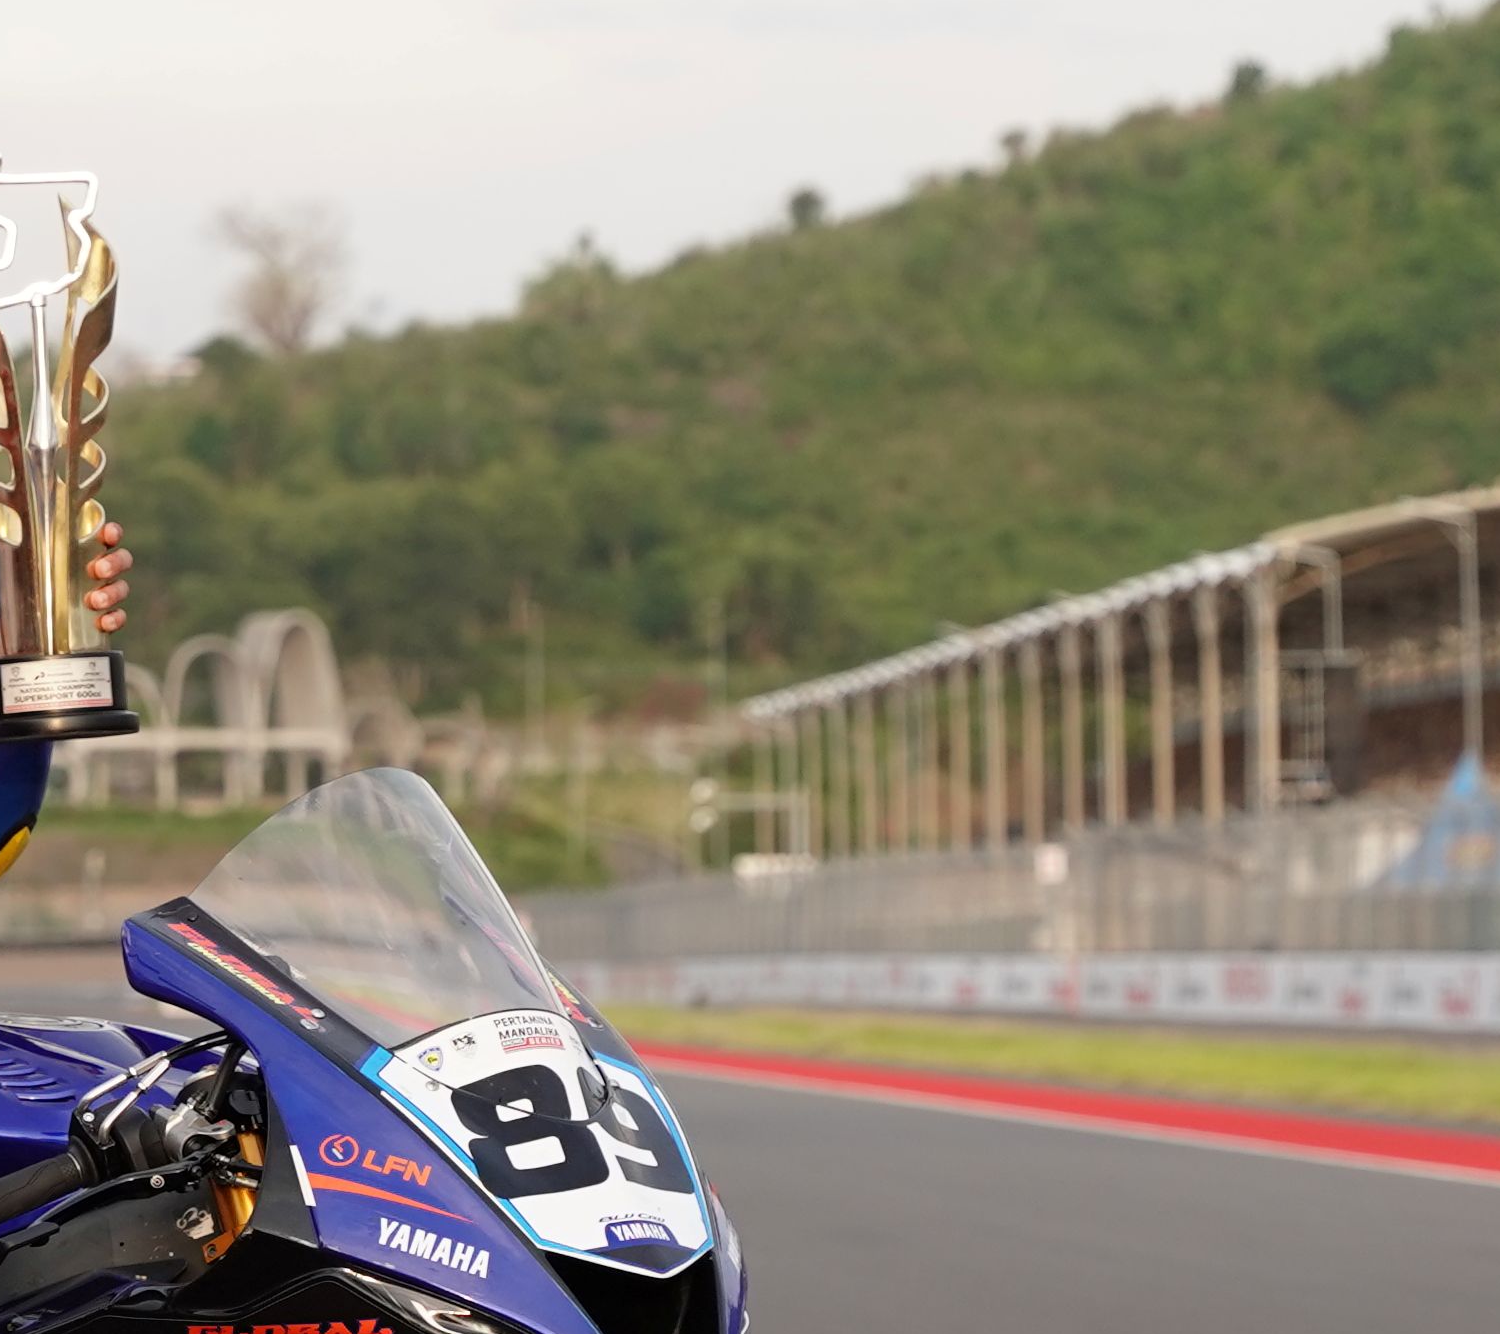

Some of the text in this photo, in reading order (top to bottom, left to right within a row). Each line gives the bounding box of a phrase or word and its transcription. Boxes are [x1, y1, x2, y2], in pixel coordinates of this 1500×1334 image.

[14, 692, 74, 704] SUPERSPORT
[494, 1015, 553, 1029] PERTAMINA
[499, 1026, 560, 1041] MANDALIKA
[451, 1064, 696, 1200] 89
[362, 1149, 432, 1187] LFN
[610, 1225, 672, 1242] YAMAHA
[377, 1217, 490, 1279] YAMAHA
